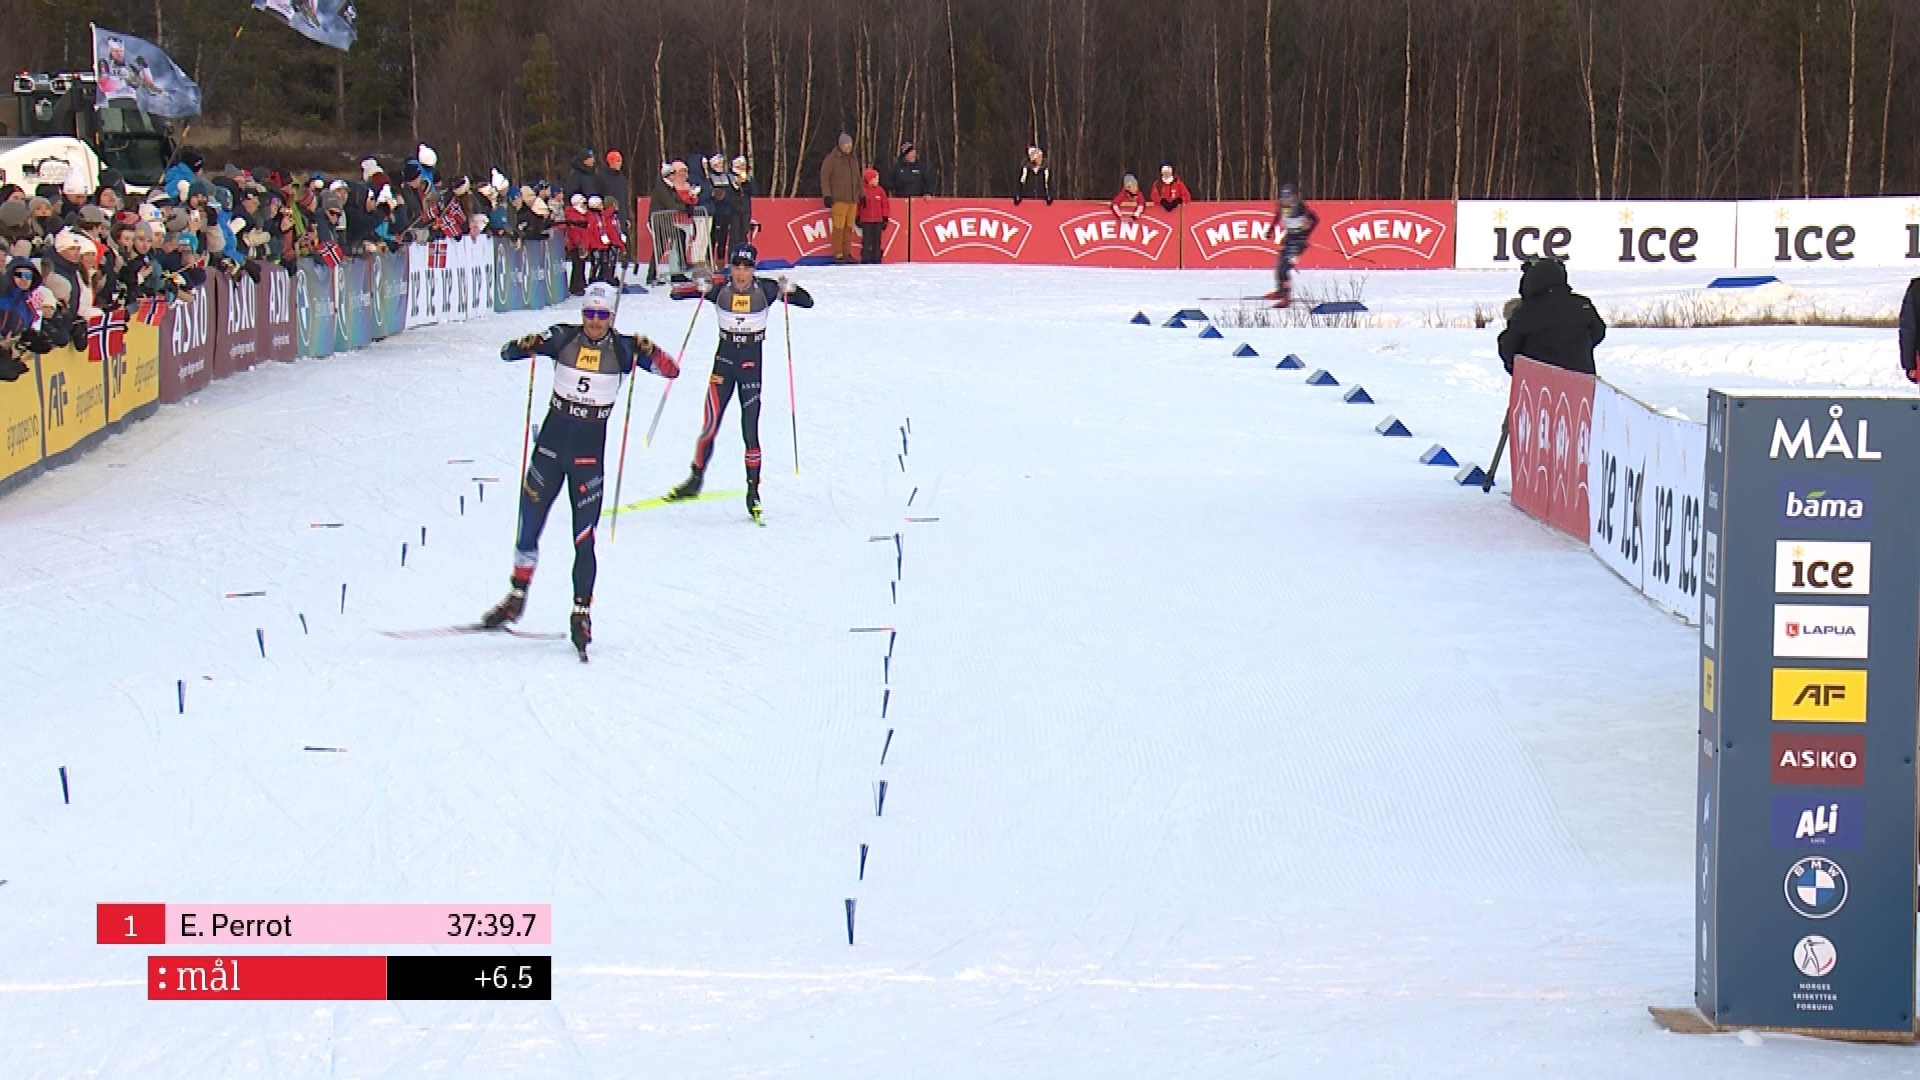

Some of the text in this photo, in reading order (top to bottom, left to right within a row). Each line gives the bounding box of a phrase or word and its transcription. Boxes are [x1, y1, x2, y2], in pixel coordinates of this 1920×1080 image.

[933, 216, 1019, 243] MENY
[1074, 219, 1159, 246] MENY
[1205, 219, 1288, 247] MENY
[1347, 219, 1432, 246] MENY
[1493, 207, 1572, 262] ice
[1618, 207, 1699, 263] ice
[1774, 206, 1856, 262] ice
[228, 275, 255, 334] ASKO
[172, 286, 208, 356] ASKO
[576, 376, 591, 393] 5
[48, 370, 68, 430] AF
[569, 403, 588, 418] ice
[1769, 404, 1882, 459] MÅL
[1786, 490, 1863, 519] bama
[1791, 546, 1854, 588] ice
[1802, 625, 1856, 636] LAPUA
[1793, 684, 1846, 707] AF
[1779, 749, 1858, 769] ASKO
[1793, 859, 1840, 877] BMW
[1792, 993, 1837, 1001] SKISKYTTER
[1799, 983, 1831, 991] NORGES
[1796, 1003, 1834, 1011] FORBUND
